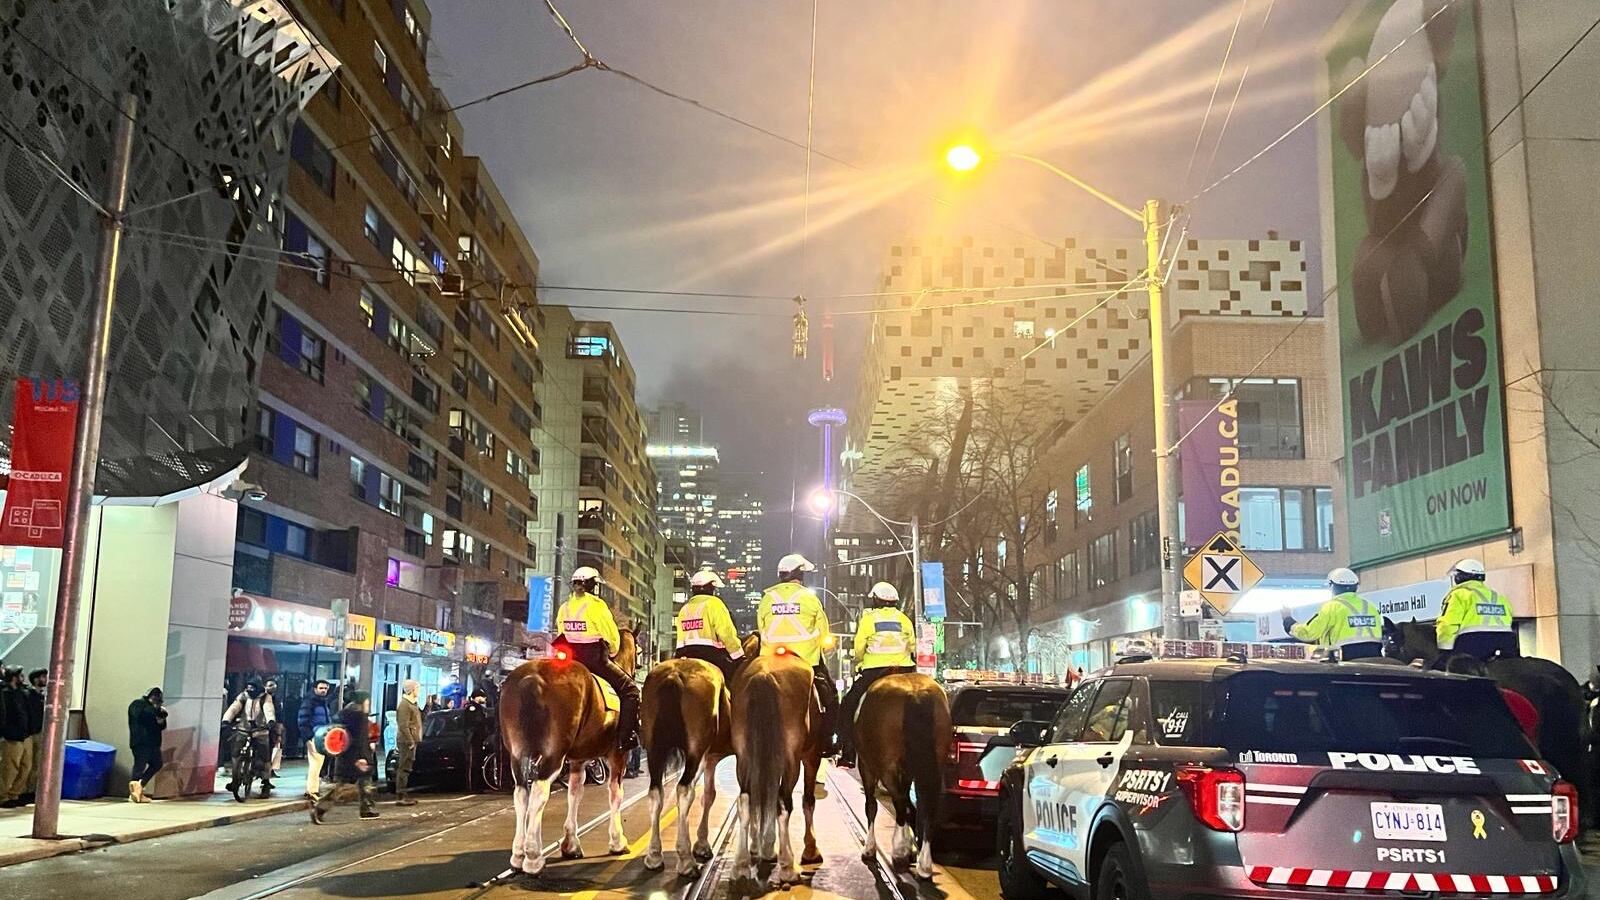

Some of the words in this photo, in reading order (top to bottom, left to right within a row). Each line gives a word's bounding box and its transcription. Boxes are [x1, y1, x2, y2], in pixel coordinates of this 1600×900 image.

[1350, 308, 1487, 437] KAWS
[1352, 385, 1490, 498] FAMILY
[1427, 495, 1448, 516] ON
[1452, 477, 1488, 508] NOW
[772, 604, 800, 614] POLICE
[1377, 600, 1410, 615] Jackman
[1411, 594, 1427, 610] Hall
[1477, 604, 1505, 615] POLICE
[563, 621, 587, 630] POLICE
[682, 620, 704, 631] POLICE
[1349, 617, 1376, 627] POLICE
[1167, 719, 1187, 733] 911
[1254, 751, 1298, 763] TORONTO
[1327, 751, 1482, 775] POLICE
[1118, 769, 1171, 792] PSRTS1
[1115, 790, 1160, 808] SUPERVISOR
[1036, 800, 1077, 834] POLICE
[1377, 848, 1446, 863] PSRTS1
